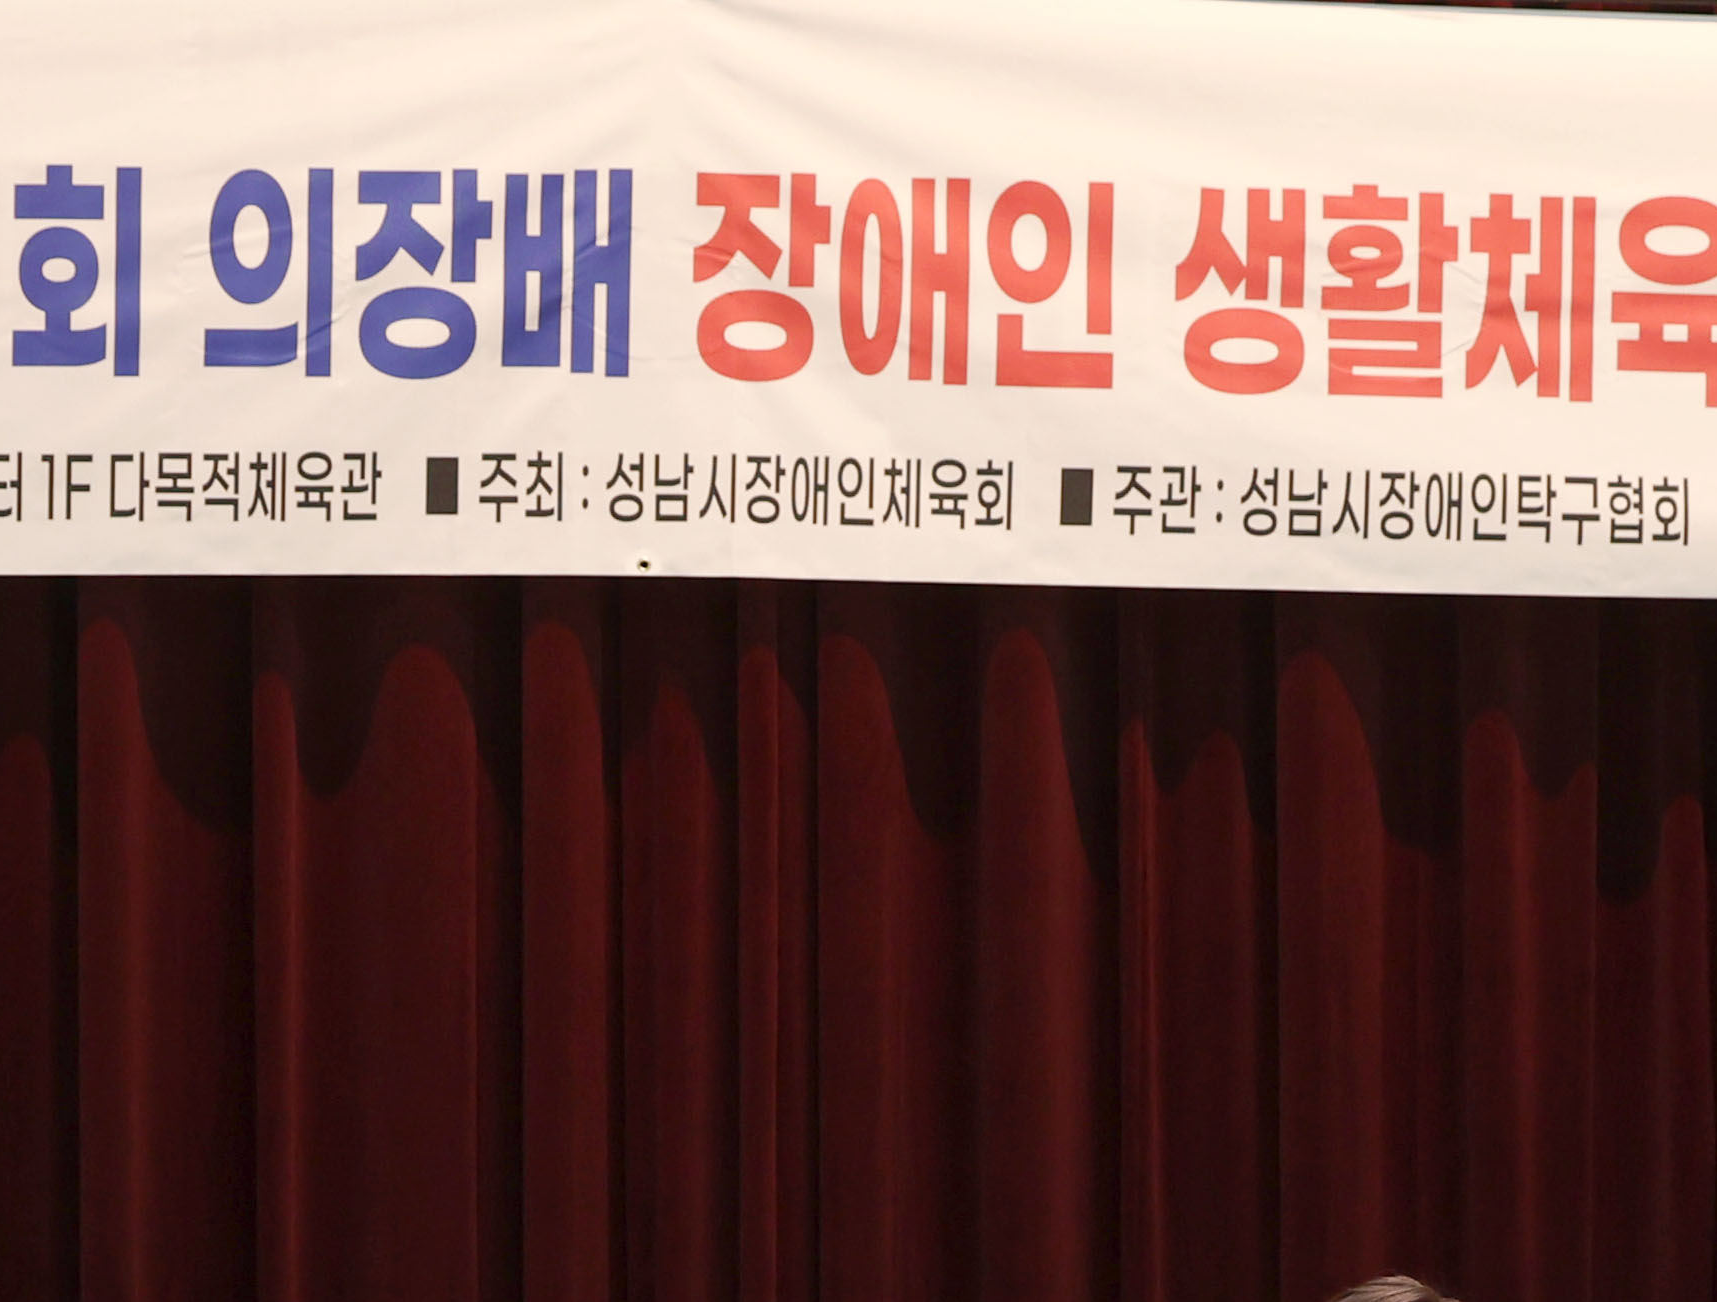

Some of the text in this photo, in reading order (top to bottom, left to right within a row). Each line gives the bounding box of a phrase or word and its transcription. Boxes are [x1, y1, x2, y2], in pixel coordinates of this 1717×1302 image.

[204, 169, 632, 379] 의장배
[693, 173, 1113, 389] 장애인
[607, 453, 1013, 530] 성남시장애인체육회
[1241, 468, 1688, 546] 성남시장애인탁구협회
